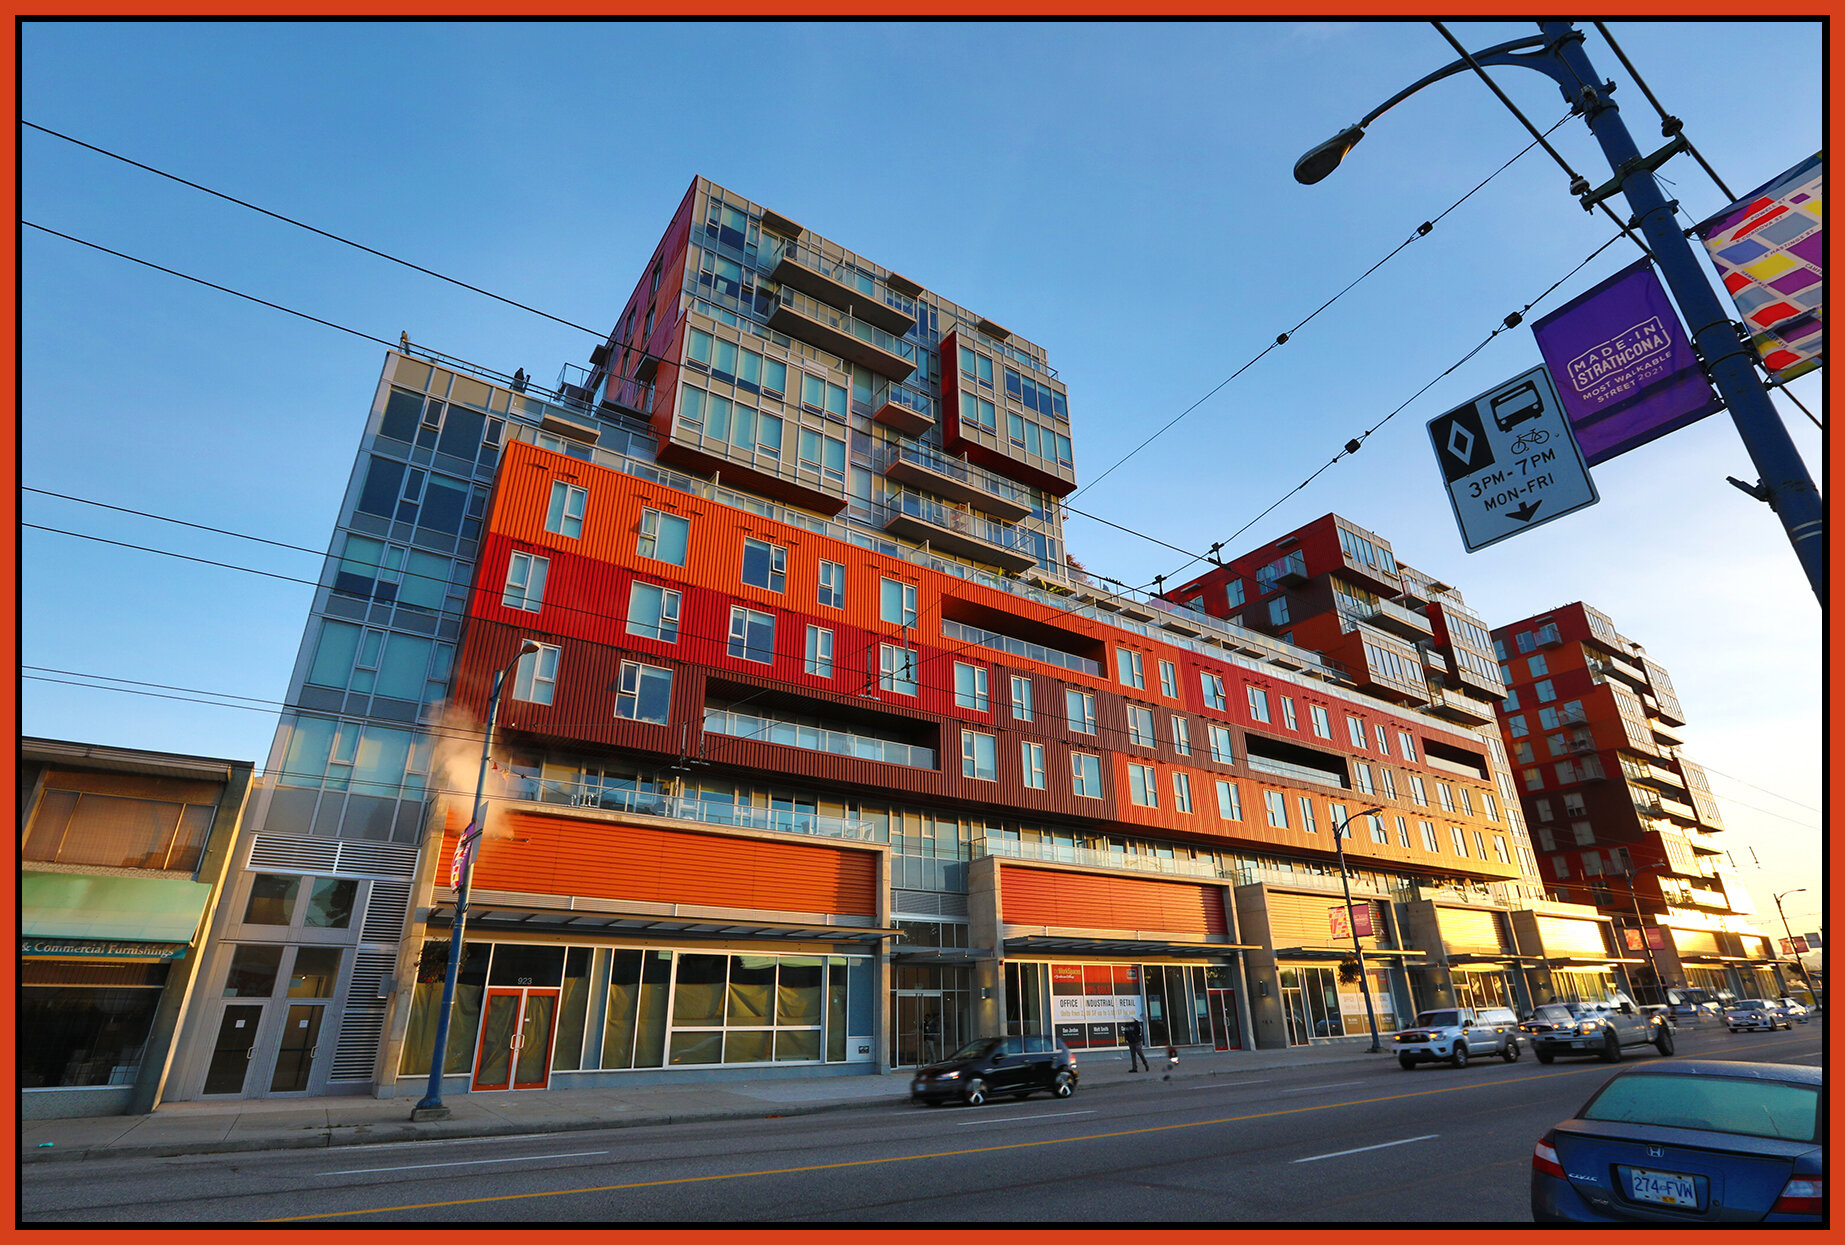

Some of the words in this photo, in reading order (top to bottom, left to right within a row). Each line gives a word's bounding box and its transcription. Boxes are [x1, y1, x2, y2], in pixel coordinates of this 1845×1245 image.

[1742, 221, 1773, 241] CORDOVA
[1770, 235, 1804, 255] HASTINGS
[1577, 334, 1664, 385] STRATHCONA
[1582, 380, 1612, 400] MOST
[1614, 351, 1672, 383] WALKABLE
[1597, 380, 1636, 403] STREET
[1637, 365, 1664, 381] 2021
[1484, 472, 1554, 512] MON-FRI
[34, 941, 105, 955] Commercial
[107, 943, 174, 958] Furnishings
[517, 976, 533, 985] 923
[1060, 999, 1078, 1007] OFFICE
[1086, 999, 1114, 1007] NDUSTRIAL
[1119, 999, 1136, 1007] RETAIL
